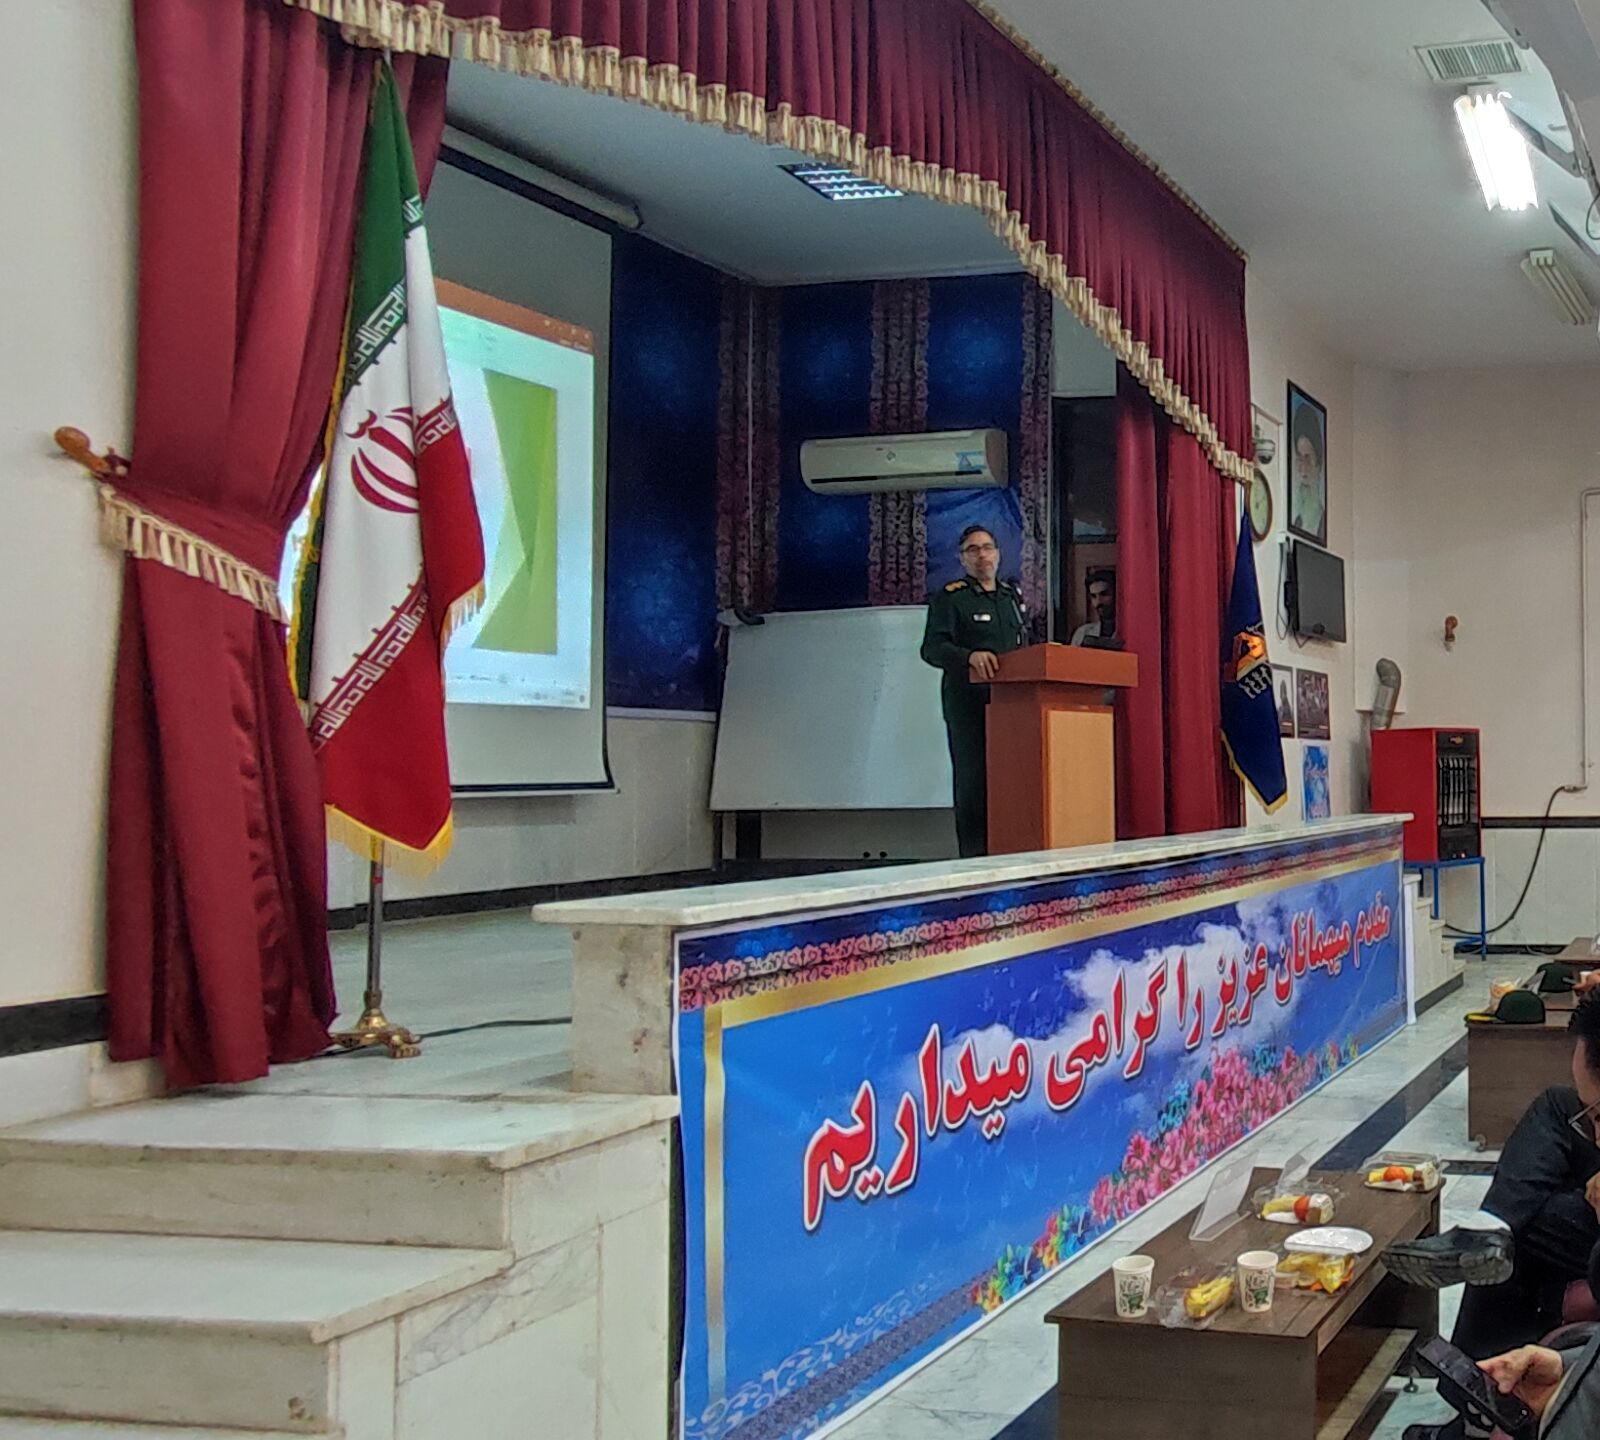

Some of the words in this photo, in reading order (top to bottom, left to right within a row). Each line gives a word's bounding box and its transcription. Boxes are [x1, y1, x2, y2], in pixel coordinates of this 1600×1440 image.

[1274, 907, 1352, 1004] میهمانان
[1354, 890, 1391, 969] مقدم
[1046, 957, 1168, 1110] گرامی
[1176, 950, 1205, 1049] را
[1212, 942, 1269, 1037] عزیز
[804, 1022, 1033, 1231] میداریم
